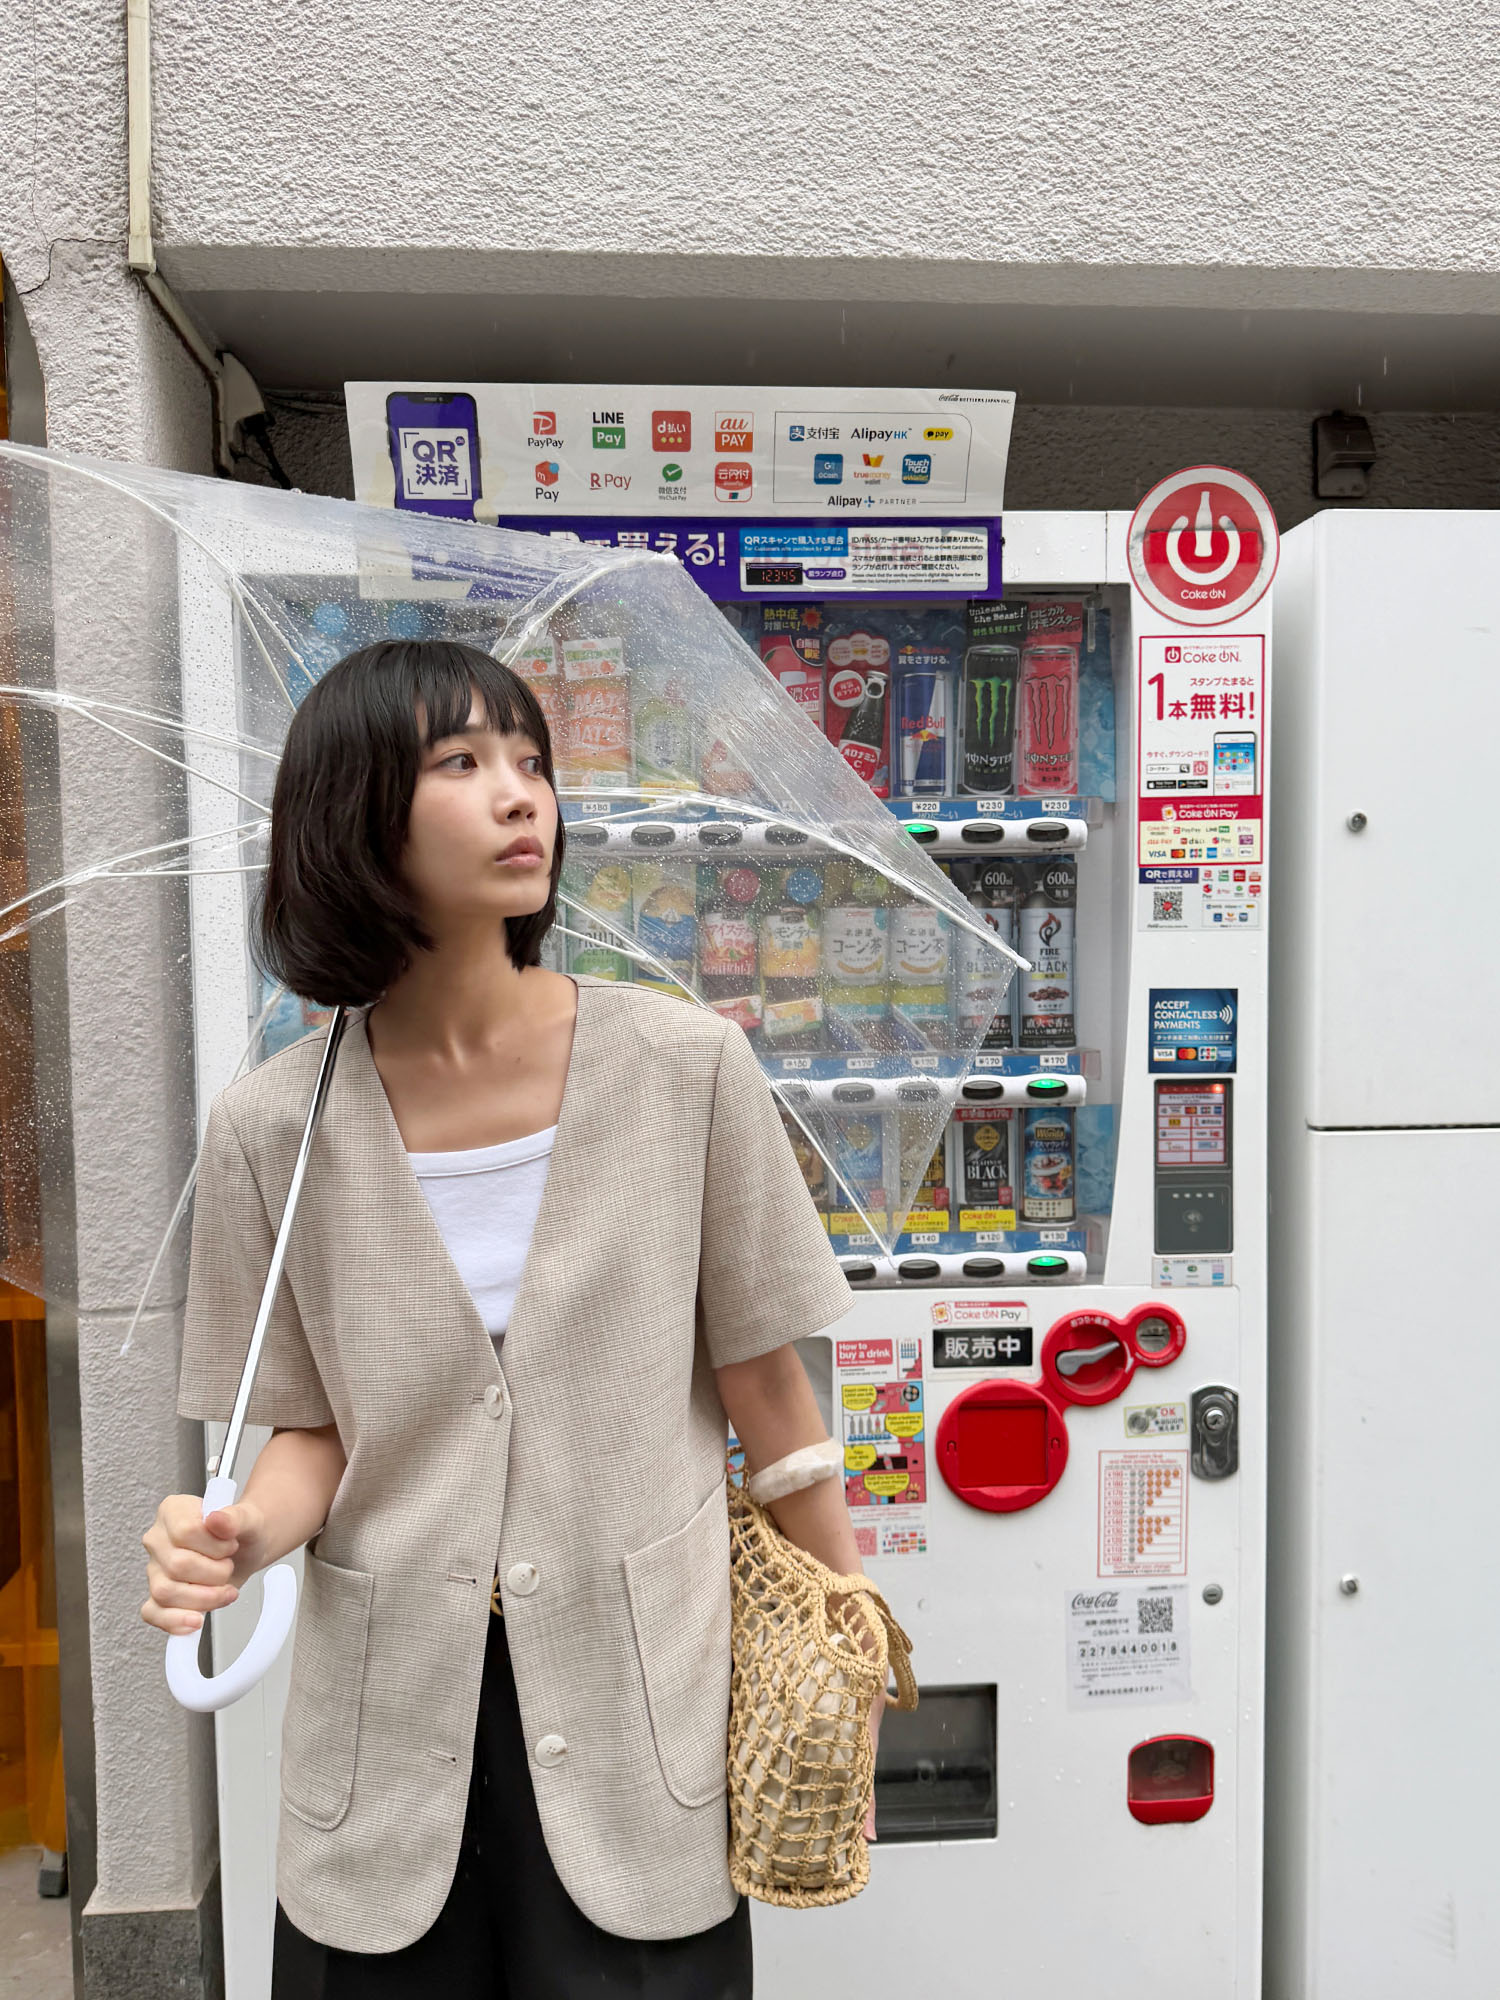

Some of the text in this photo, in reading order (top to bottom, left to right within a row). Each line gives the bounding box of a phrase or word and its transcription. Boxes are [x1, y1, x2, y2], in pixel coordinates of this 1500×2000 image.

[592, 411, 625, 424] LINE
[720, 417, 748, 430] au
[657, 420, 686, 434] d払い
[806, 426, 840, 440] 支付宝
[597, 431, 622, 446] Pay
[721, 433, 747, 446] PAY
[935, 429, 950, 439] pay
[528, 437, 564, 449] PayPay
[412, 439, 458, 463] QR
[904, 458, 930, 468] Touch
[415, 464, 460, 487] 決済
[604, 473, 632, 490] Pay
[853, 471, 891, 480] truemoney
[535, 487, 560, 503] Pay
[658, 486, 687, 495] 微信支付
[827, 495, 863, 508] Alipay
[761, 569, 796, 582] 12345
[1180, 588, 1226, 600] Coke ON
[764, 608, 799, 620] 熱中症
[969, 603, 1007, 617] Unleash
[974, 608, 1024, 623] the Beast!
[1029, 606, 1065, 619] ロピカル
[898, 656, 950, 665] 翼をさずける。
[1183, 649, 1240, 663] Coke ON
[1190, 677, 1255, 687] スタンプたまると
[1147, 672, 1255, 721] 1本無料!
[901, 716, 946, 729] Red Bull
[853, 760, 863, 769] C
[915, 803, 937, 811] ¥220
[979, 801, 1003, 810] ¥230
[1044, 801, 1068, 810] ¥230
[1178, 808, 1239, 820] Coke ON Pay
[1145, 870, 1193, 879] QRで買える!
[833, 936, 882, 955] コーン茶
[896, 937, 945, 954] コーン茶
[1040, 948, 1060, 956] FIRE
[1030, 960, 1068, 973] BLACK
[1154, 1000, 1190, 1010] ACCEPT
[1154, 1010, 1218, 1020] CONTACTLESS
[1154, 1021, 1201, 1030] PAYMENTS
[967, 1165, 1008, 1179] BLACK
[915, 1234, 936, 1242] ¥140
[954, 1309, 1021, 1321] Coke ON Pay
[839, 1342, 868, 1351] How to
[944, 1336, 1021, 1360] 販売中
[839, 1351, 857, 1361] buy
[867, 1348, 891, 1358] drink
[1160, 1408, 1176, 1417] OK
[1071, 1591, 1120, 1610] Coca-Cola
